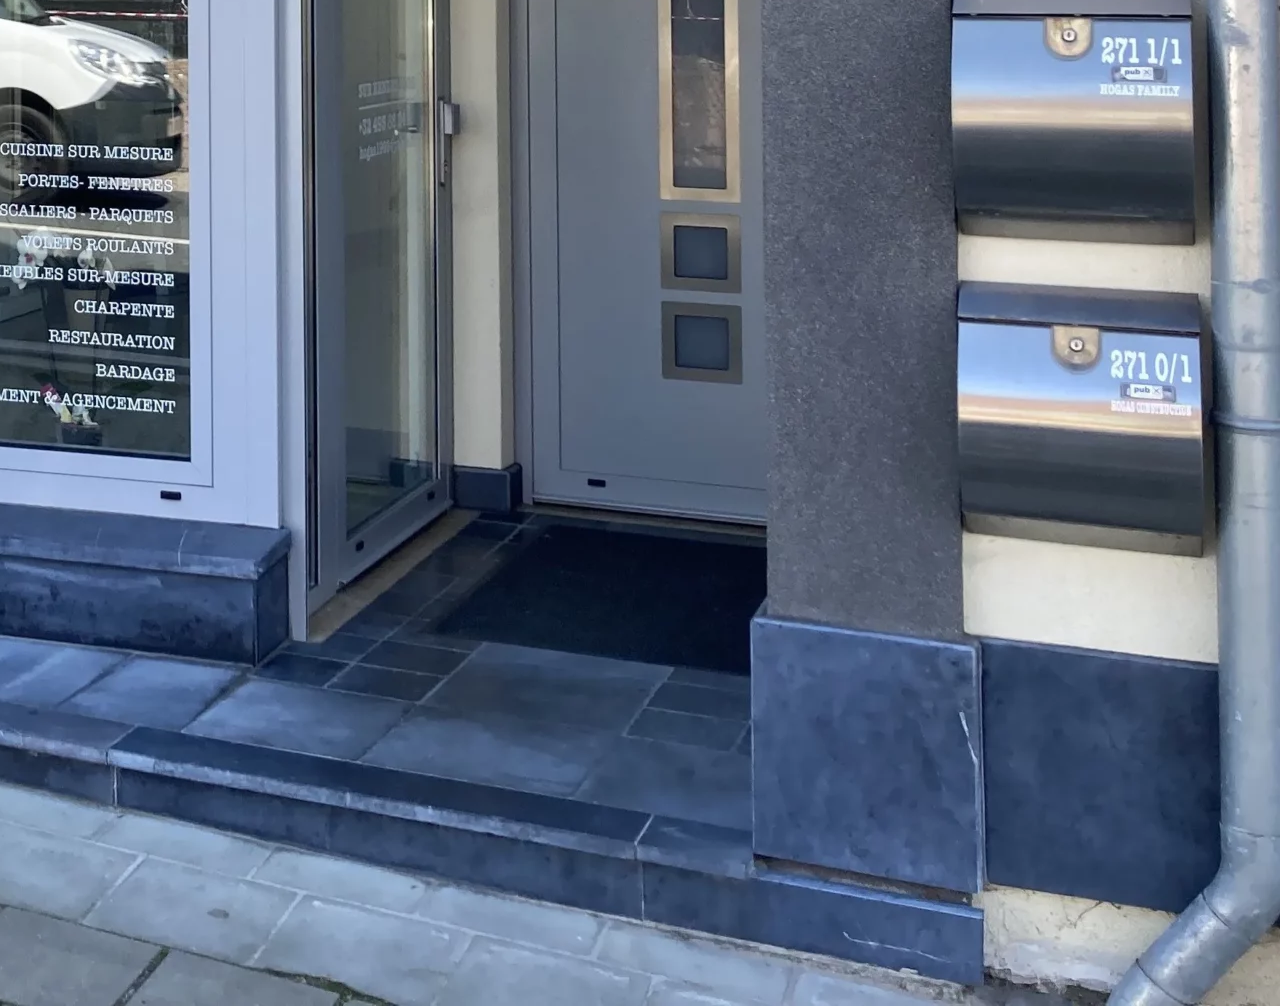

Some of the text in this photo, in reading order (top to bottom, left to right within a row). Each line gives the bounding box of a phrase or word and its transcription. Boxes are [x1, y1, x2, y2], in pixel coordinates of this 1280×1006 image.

[1101, 37, 1182, 66] 271 1/1
[1099, 84, 1180, 96] HOGAS FAMILY
[0, 142, 173, 161] CUISINE SUR MESURE
[18, 174, 173, 192] PORTES- FENETRES
[89, 207, 174, 225] PARQUETS
[21, 235, 174, 255] VOLETS ROULANTS
[74, 300, 175, 318] CHARPENTE
[48, 329, 175, 350] RESTAURATION
[96, 364, 175, 382] BARDAGE
[1110, 349, 1192, 384] 271 0/1
[44, 391, 58, 404] &
[62, 393, 176, 414] AGENCEMENT
